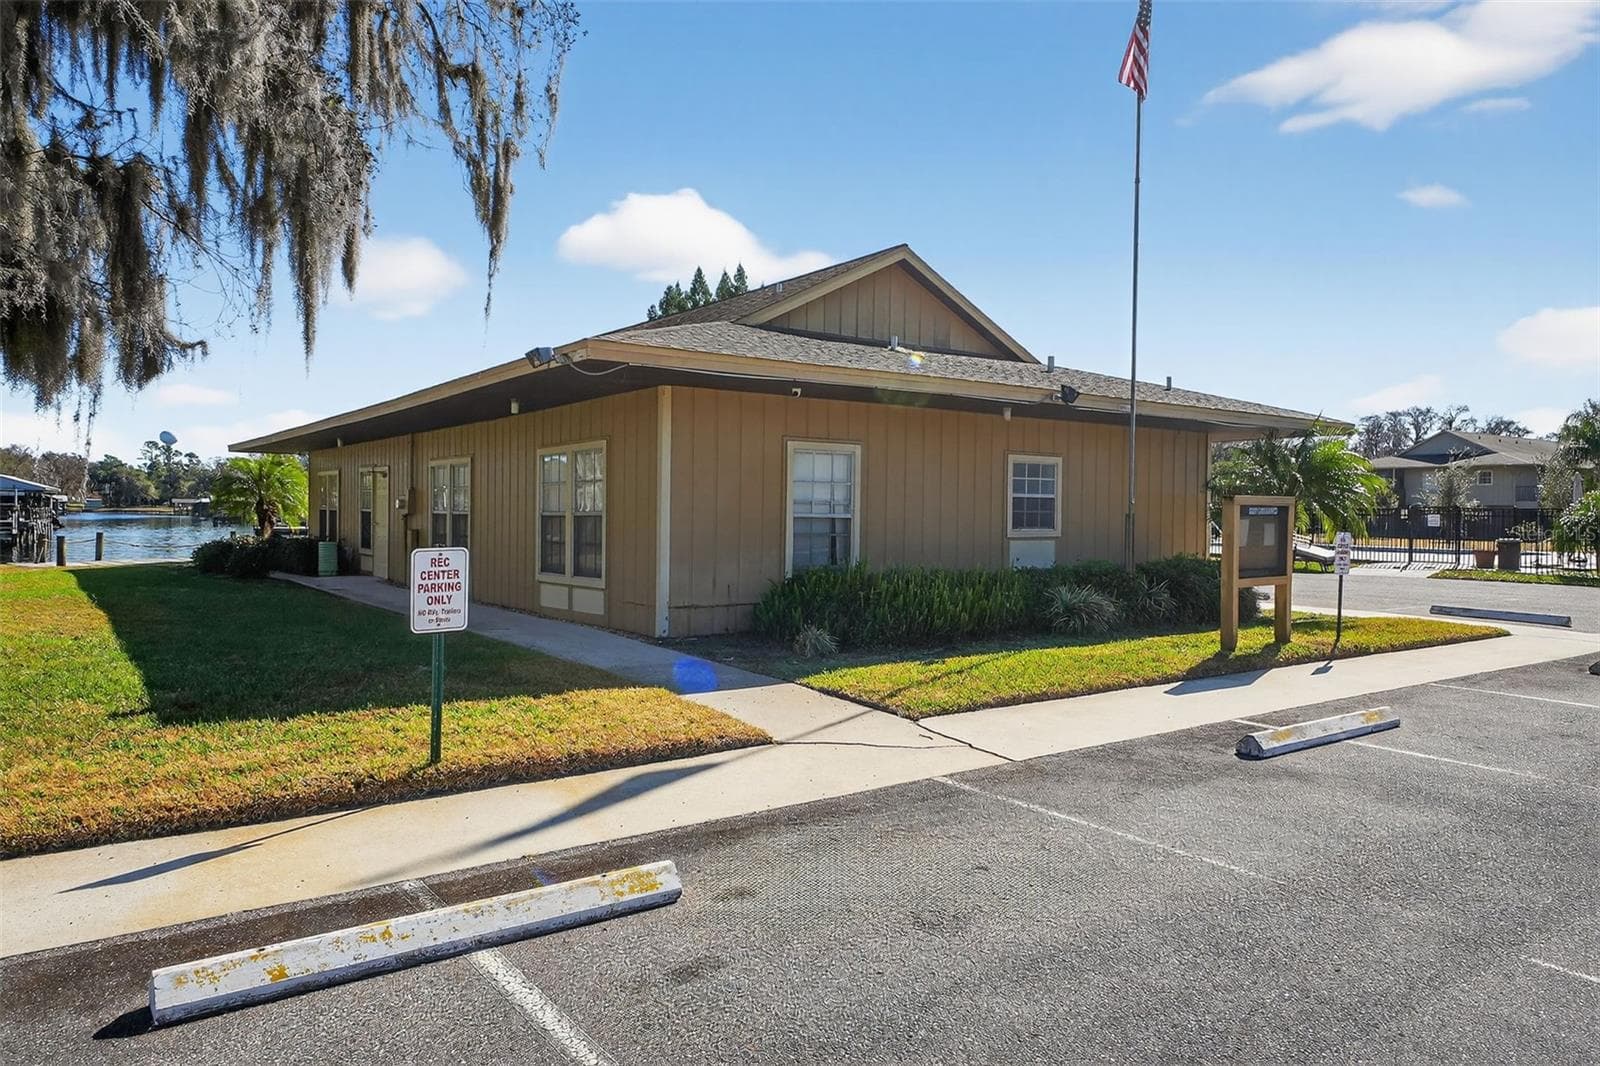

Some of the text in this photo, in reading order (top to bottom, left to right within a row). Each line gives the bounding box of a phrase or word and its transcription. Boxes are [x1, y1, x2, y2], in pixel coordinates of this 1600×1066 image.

[430, 557, 450, 568] REC
[420, 569, 460, 581] CENTER
[417, 582, 462, 594] PARKING
[426, 595, 453, 606] ONLY
